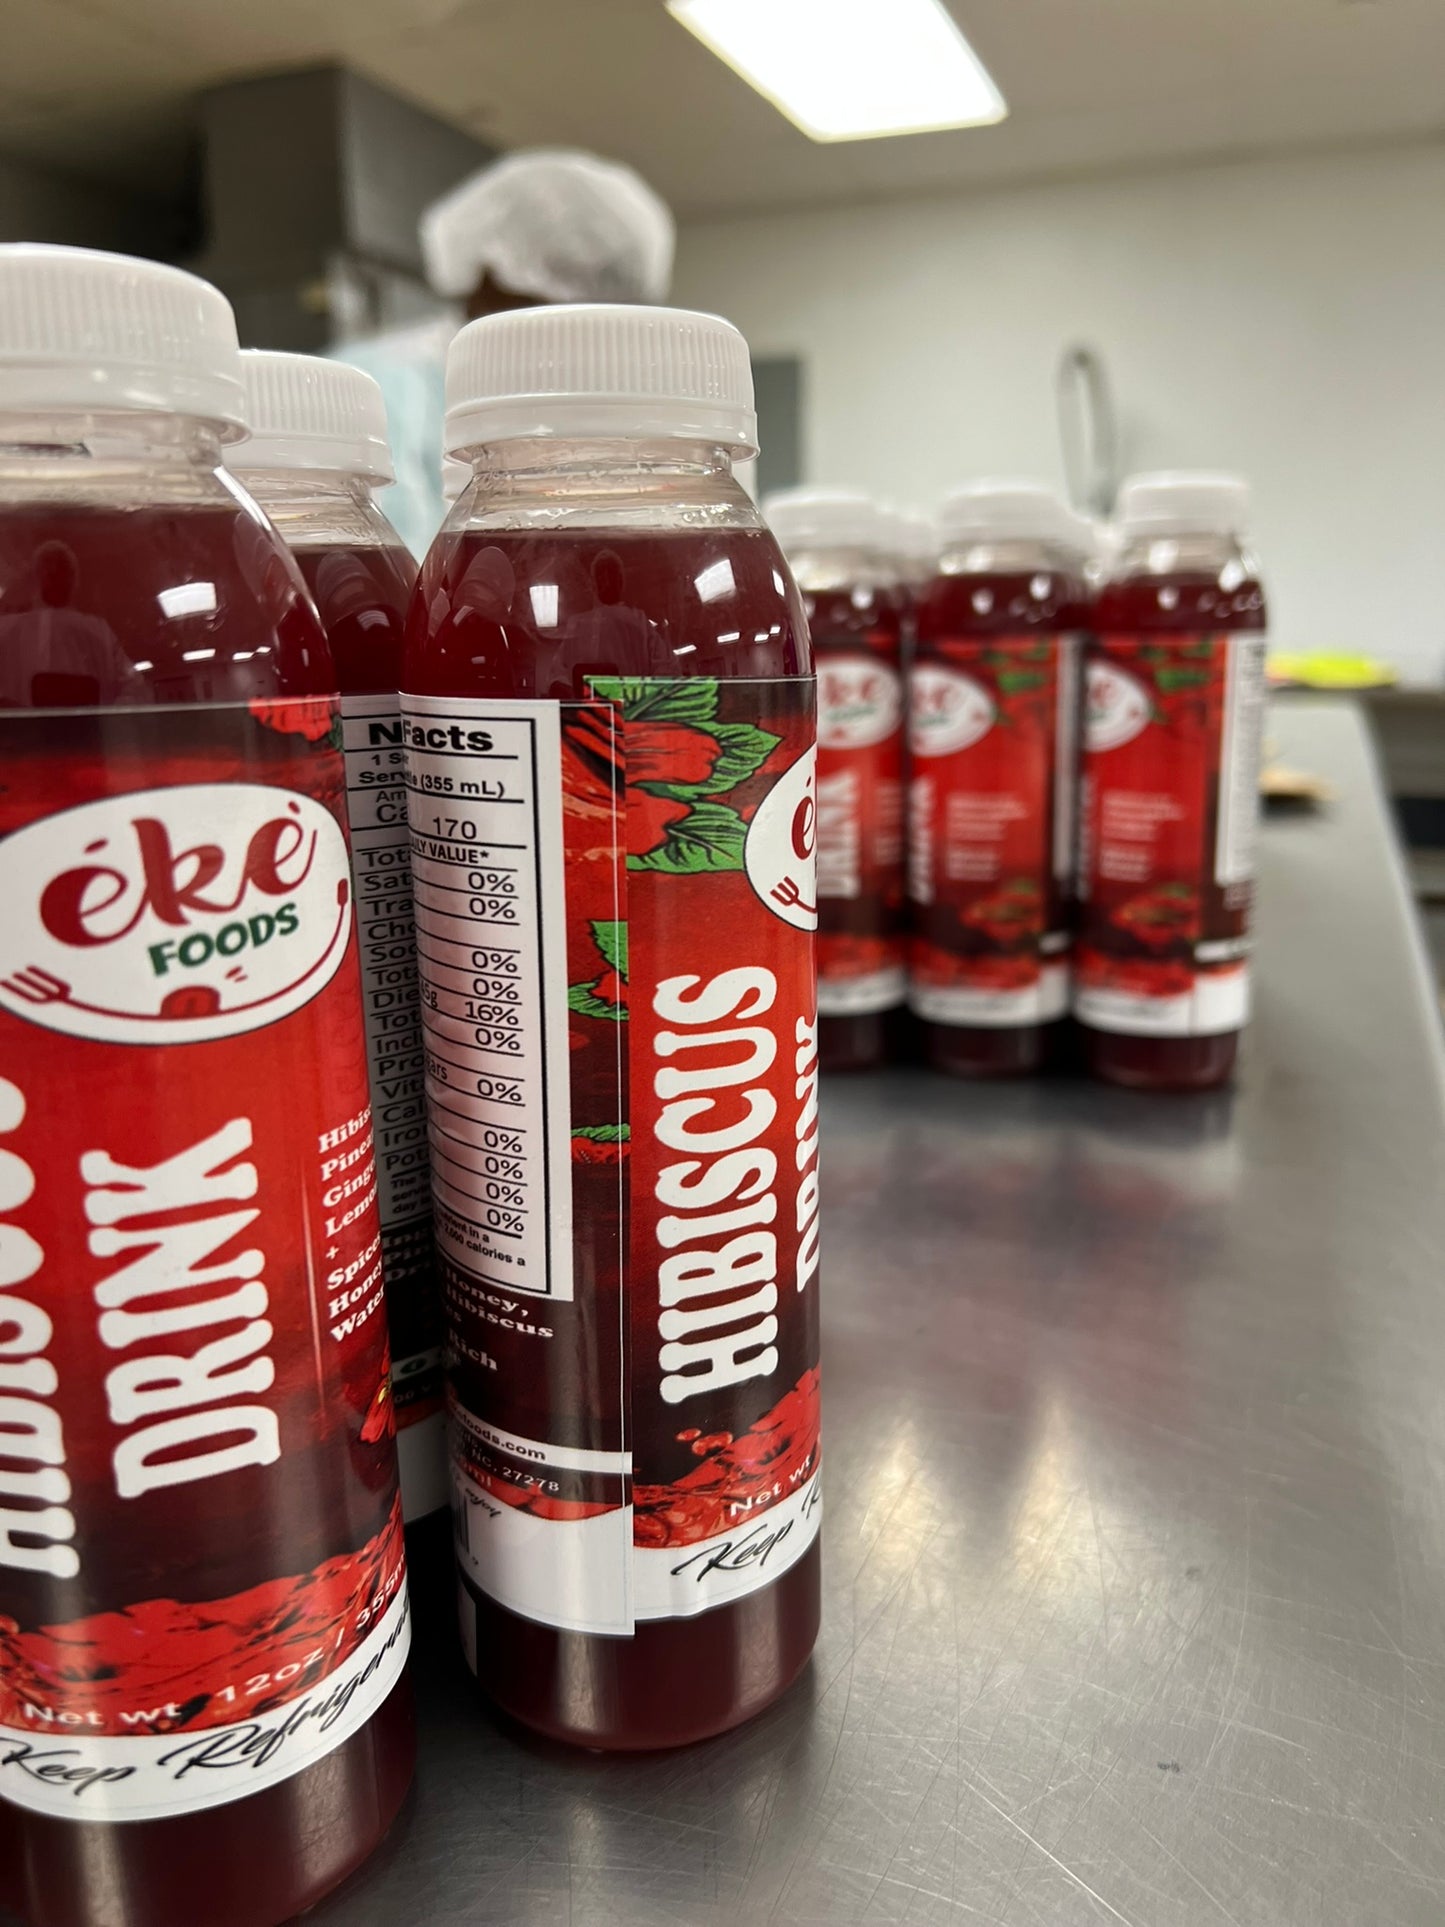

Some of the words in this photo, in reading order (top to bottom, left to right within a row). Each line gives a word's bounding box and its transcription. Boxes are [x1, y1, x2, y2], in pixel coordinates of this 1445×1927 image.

[402, 719, 494, 752] Facts
[460, 781, 505, 799] mL)
[433, 817, 478, 840] 170
[467, 870, 516, 894] 0%
[468, 897, 517, 920] 0%
[148, 902, 300, 979] FOODS
[471, 950, 519, 974] 0%
[472, 977, 520, 1001] 0%
[464, 1001, 520, 1028] 16%
[475, 1027, 522, 1052] 0%
[476, 1078, 523, 1103] 0%
[483, 1130, 524, 1154] 0%
[484, 1156, 525, 1180] 0%
[485, 1182, 526, 1206] 0%
[652, 965, 778, 1404] HIBISCUS
[486, 1208, 526, 1233] 0%
[325, 1245, 340, 1260] +
[466, 1238, 513, 1264] calories
[516, 1256, 526, 1267] a
[80, 1117, 282, 1499] DRINK
[503, 1467, 560, 1493] 27278
[730, 1481, 782, 1517] Net
[670, 1518, 795, 1583] Keep
[24, 1702, 103, 1726] Net
[119, 1701, 182, 1726] wt
[214, 1651, 324, 1702] 12oz
[0, 1737, 137, 1796] Keep
